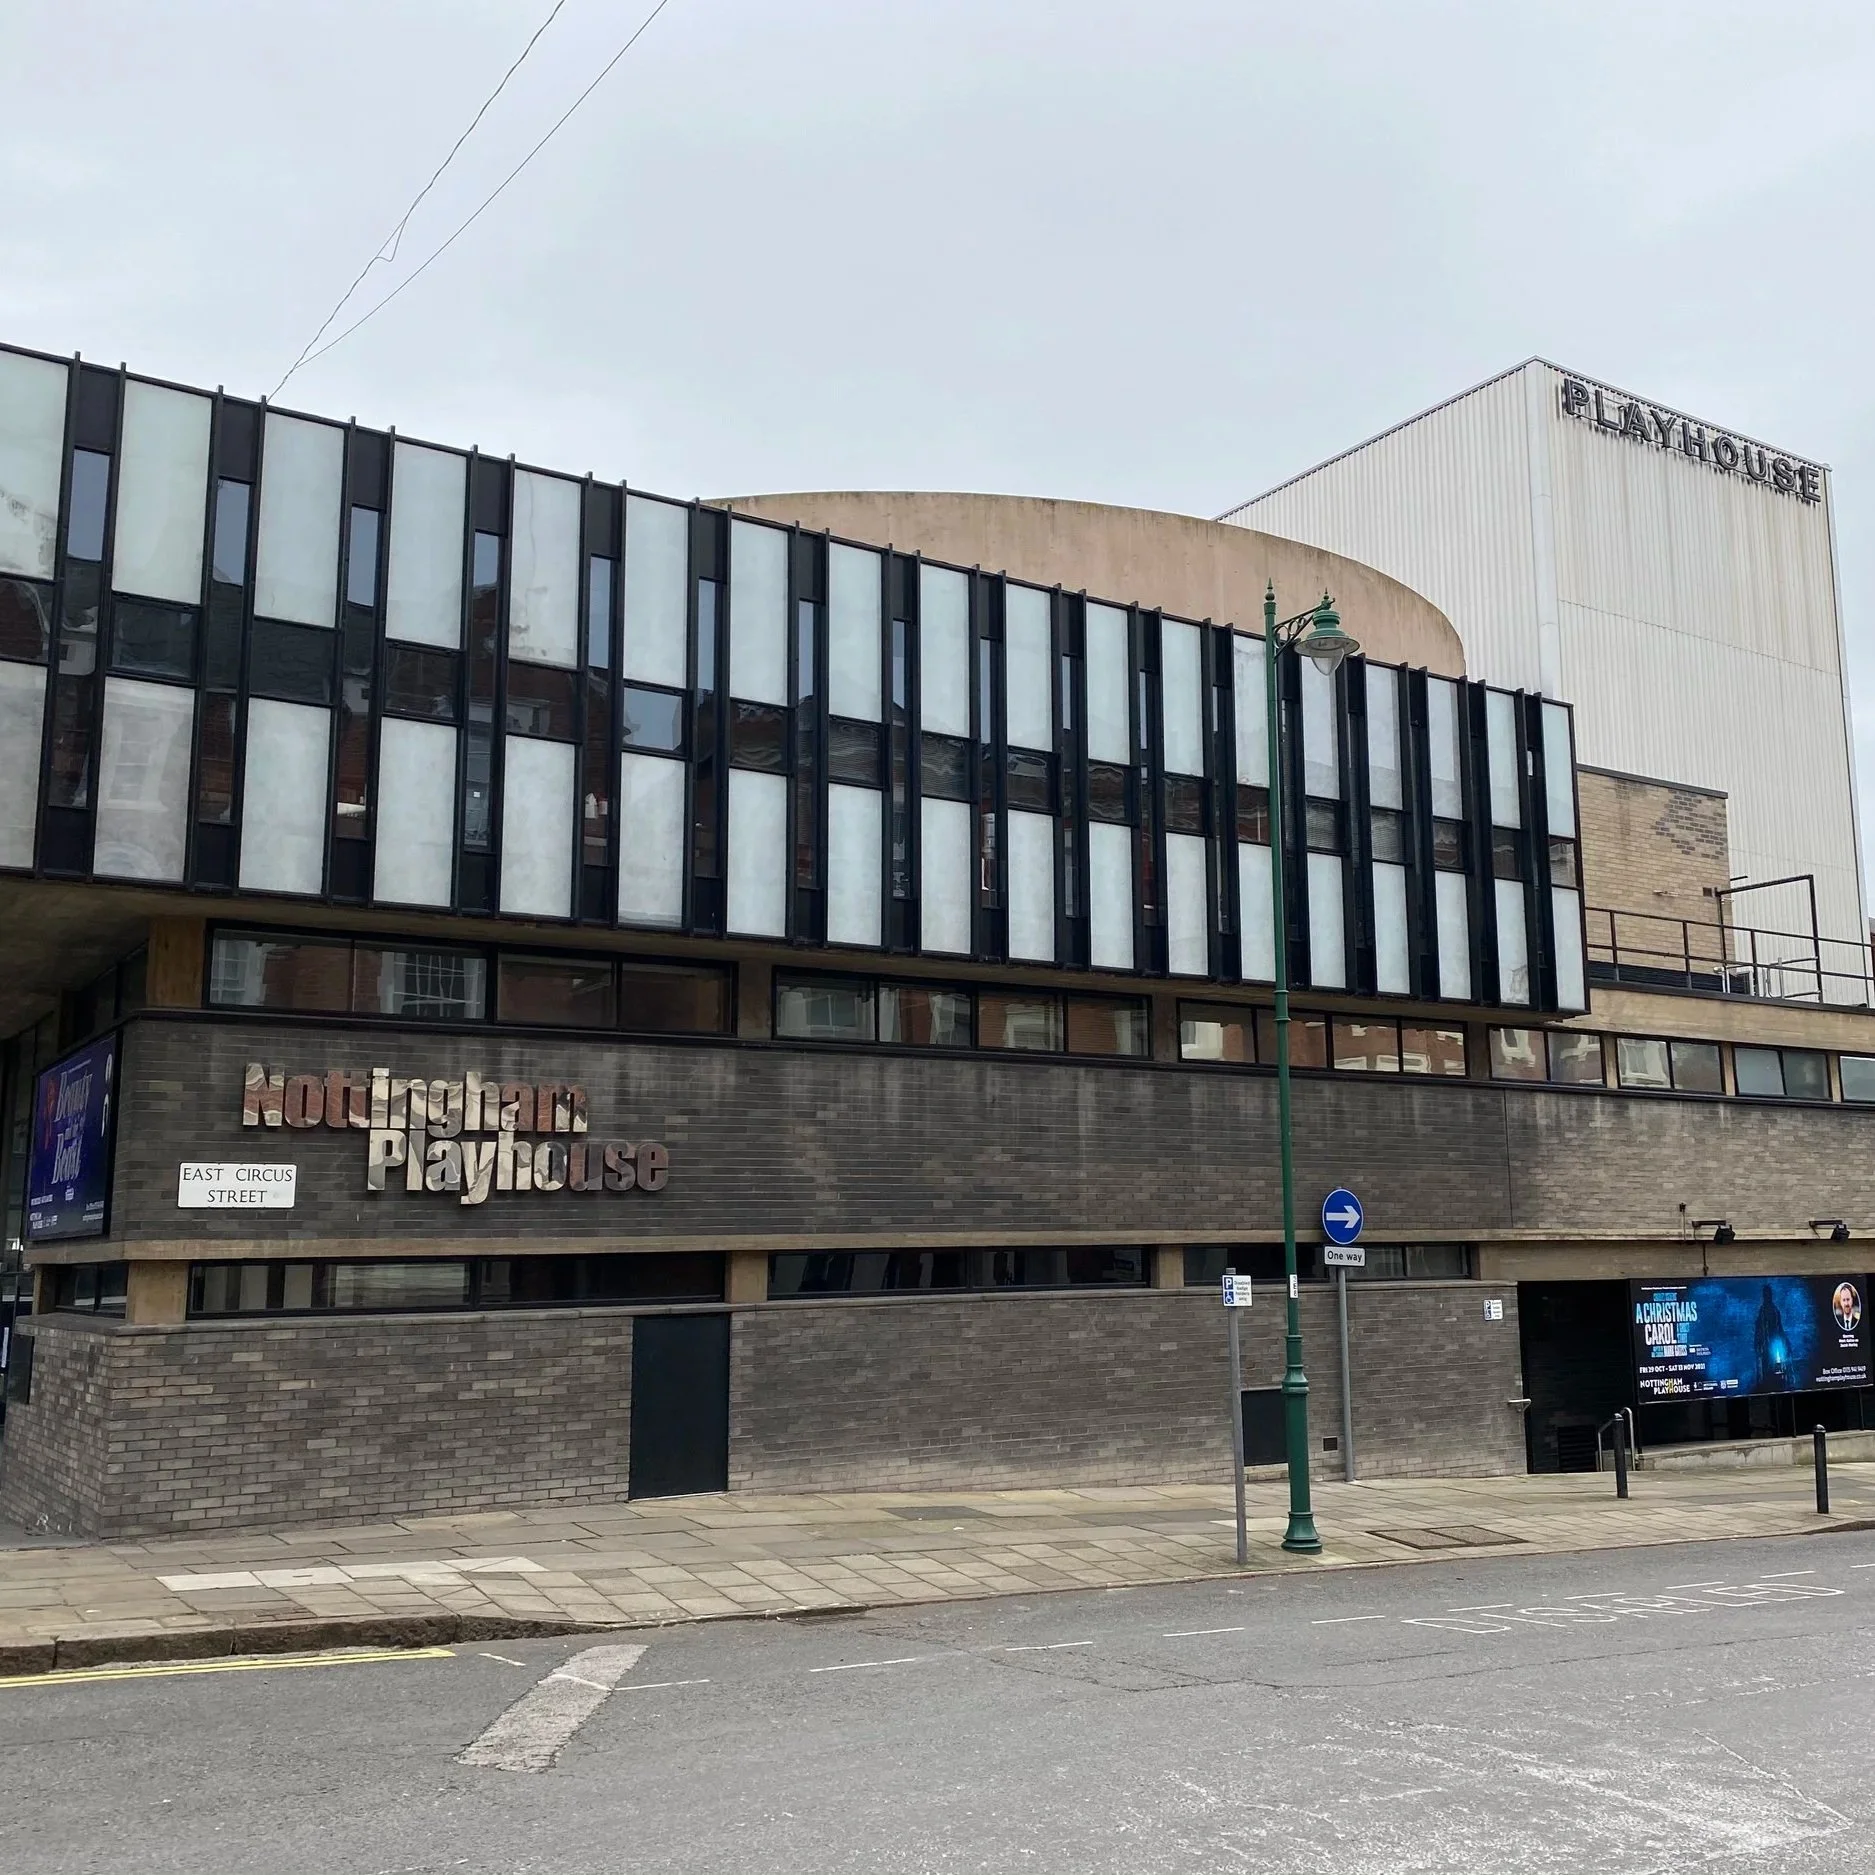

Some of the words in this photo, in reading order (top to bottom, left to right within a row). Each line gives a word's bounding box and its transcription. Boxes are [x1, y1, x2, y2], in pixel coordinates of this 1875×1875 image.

[1564, 378, 1821, 502] PLAYHOUSE
[242, 1062, 588, 1138] Nottingham
[183, 1167, 224, 1181] EAST
[235, 1168, 293, 1182] CIRCUS
[367, 1129, 669, 1205] Playhouse
[207, 1189, 267, 1203] STREET
[1327, 1250, 1344, 1260] One
[1346, 1253, 1362, 1263] way
[1635, 1303, 1644, 1324] A
[1643, 1301, 1698, 1324] CHRISTMAS
[1644, 1322, 1677, 1346] CAROL
[1654, 1365, 1665, 1373] OCT
[1668, 1364, 1677, 1372] SAT
[1683, 1363, 1694, 1371] NOV
[1640, 1378, 1683, 1388] NOTTINGHAM
[1653, 1384, 1691, 1395] PLAYHOUSE
[1401, 1582, 1845, 1634] DISABLED
